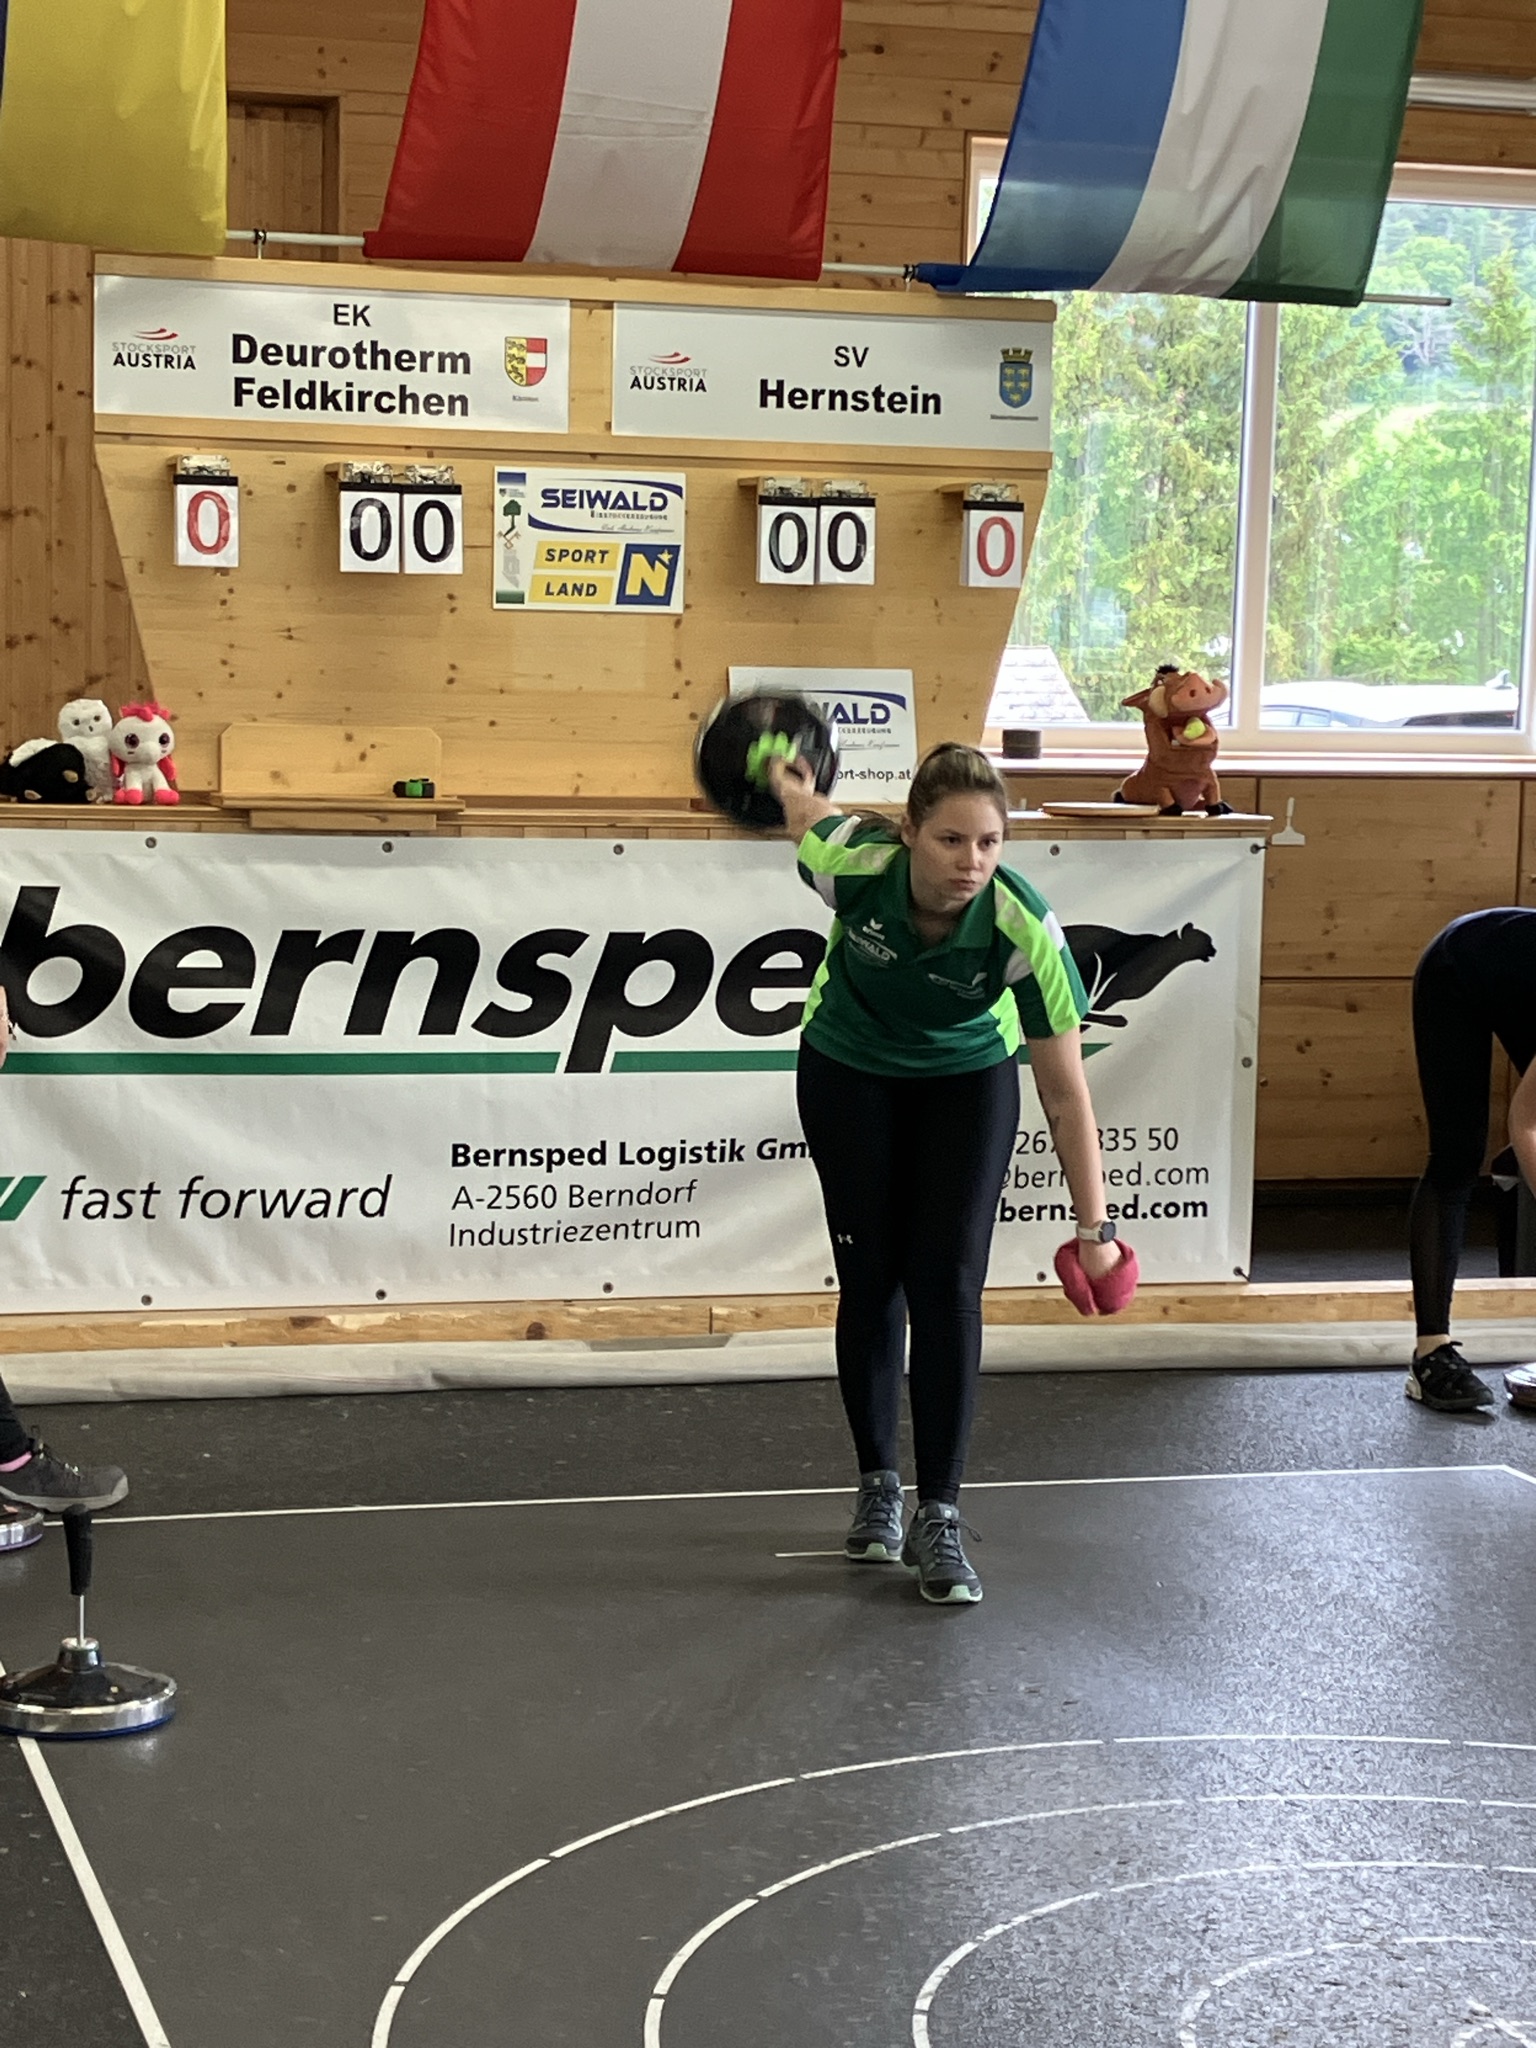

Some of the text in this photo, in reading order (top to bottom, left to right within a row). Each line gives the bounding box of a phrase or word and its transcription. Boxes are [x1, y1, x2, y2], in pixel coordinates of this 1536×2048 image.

[333, 303, 371, 327] EK
[112, 341, 197, 355] STOCKSPORT
[231, 333, 471, 375] Deurotherm
[833, 345, 870, 368] SV
[112, 352, 196, 370] AUSTRIA
[629, 365, 708, 378] STOCKSPORT
[630, 376, 707, 393] AUSTRIA
[759, 378, 942, 415] Hernstein
[233, 377, 470, 417] Feldkirchen
[540, 488, 669, 512] SEIWALD
[544, 548, 610, 564] SPORT
[544, 581, 598, 597] LAND
[808, 702, 891, 725] WALD
[837, 768, 912, 783] ort-shop.at
[0, 885, 828, 1074] bernspe
[1147, 1126, 1179, 1151] 50
[450, 1137, 813, 1173] Bernsped Logistik Gm
[61, 1173, 394, 1220] fast forward
[451, 1178, 699, 1211] A-2560 Berndorf
[449, 1217, 701, 1248] Industriezentrum
